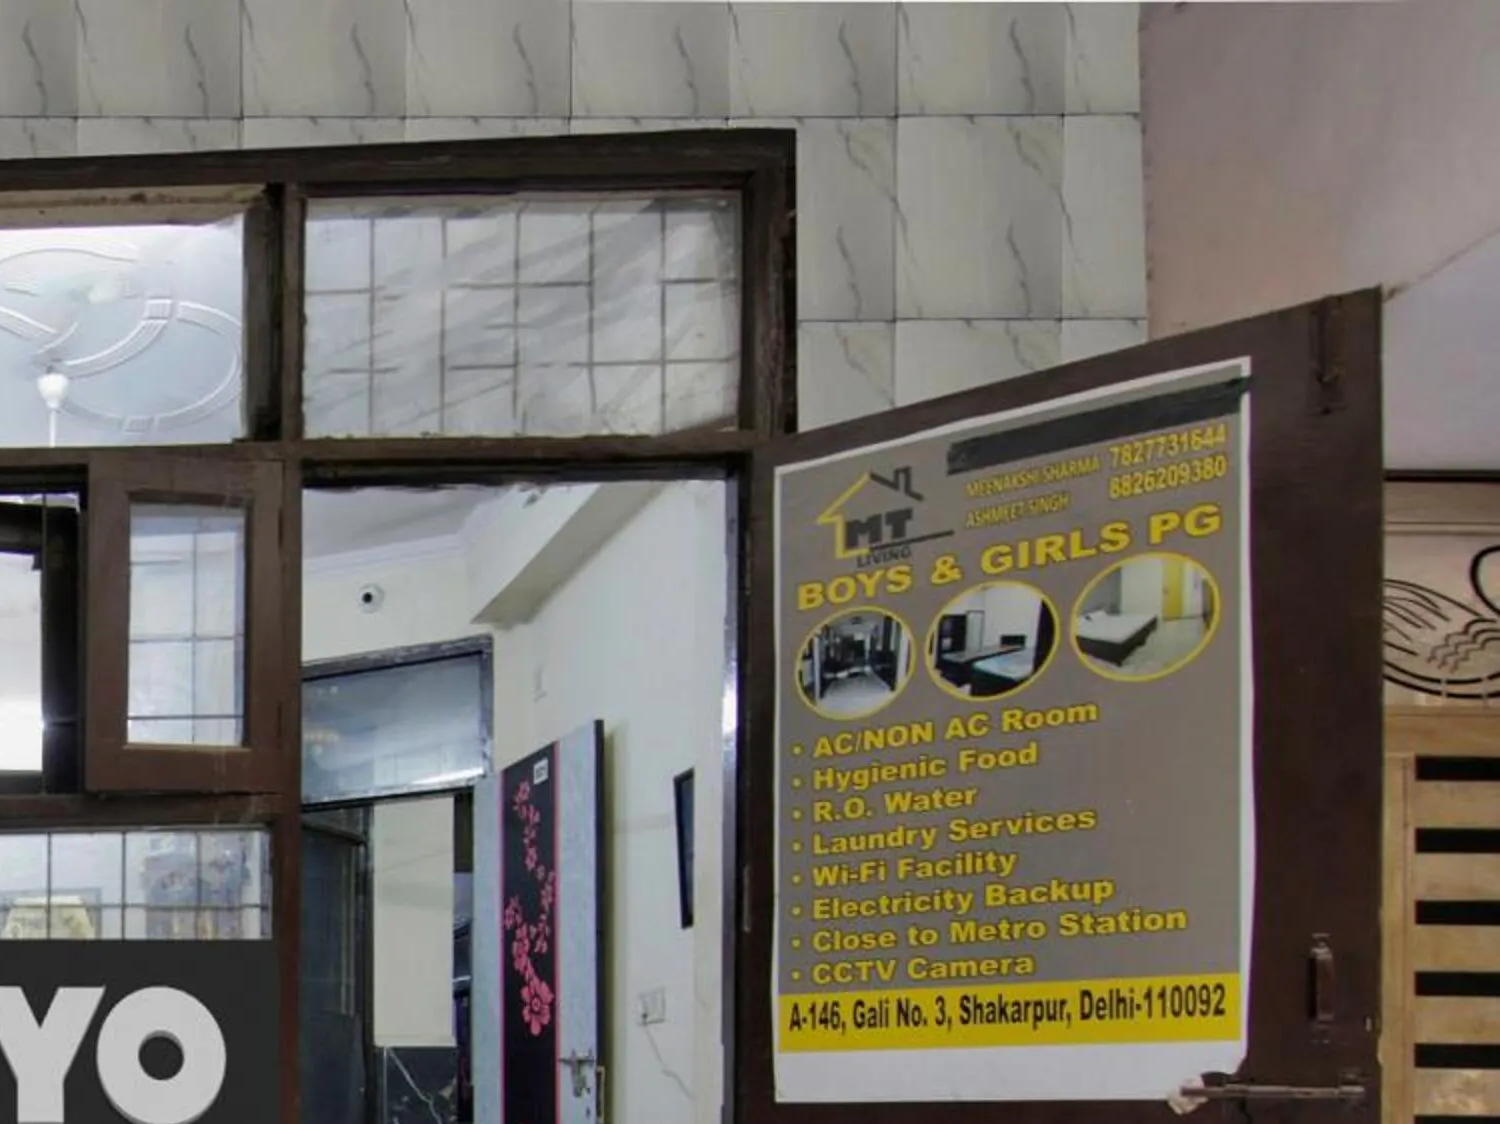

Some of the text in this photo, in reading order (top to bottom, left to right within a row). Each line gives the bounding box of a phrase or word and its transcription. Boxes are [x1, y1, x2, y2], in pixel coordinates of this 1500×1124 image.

[1042, 455, 1101, 482] SHARMA
[845, 507, 913, 549] MT
[797, 504, 1221, 611] BOYS & GIRLS PG
[856, 545, 911, 568] LIVING
[945, 714, 989, 739] AC
[1002, 703, 1099, 733] Room
[813, 741, 1039, 793] Hygienic Food
[813, 787, 977, 823] R.O. Water
[813, 808, 1096, 856] Laundry Services
[813, 850, 1018, 887] Wi-Fi Facility
[813, 878, 1114, 921] Electricity Backup
[813, 907, 1187, 953] Close to Metro Station
[813, 954, 1034, 986] CCTV Camera
[789, 983, 1226, 1034] A-146, Gali No. 3, Shakarpur, Delhi-110092
